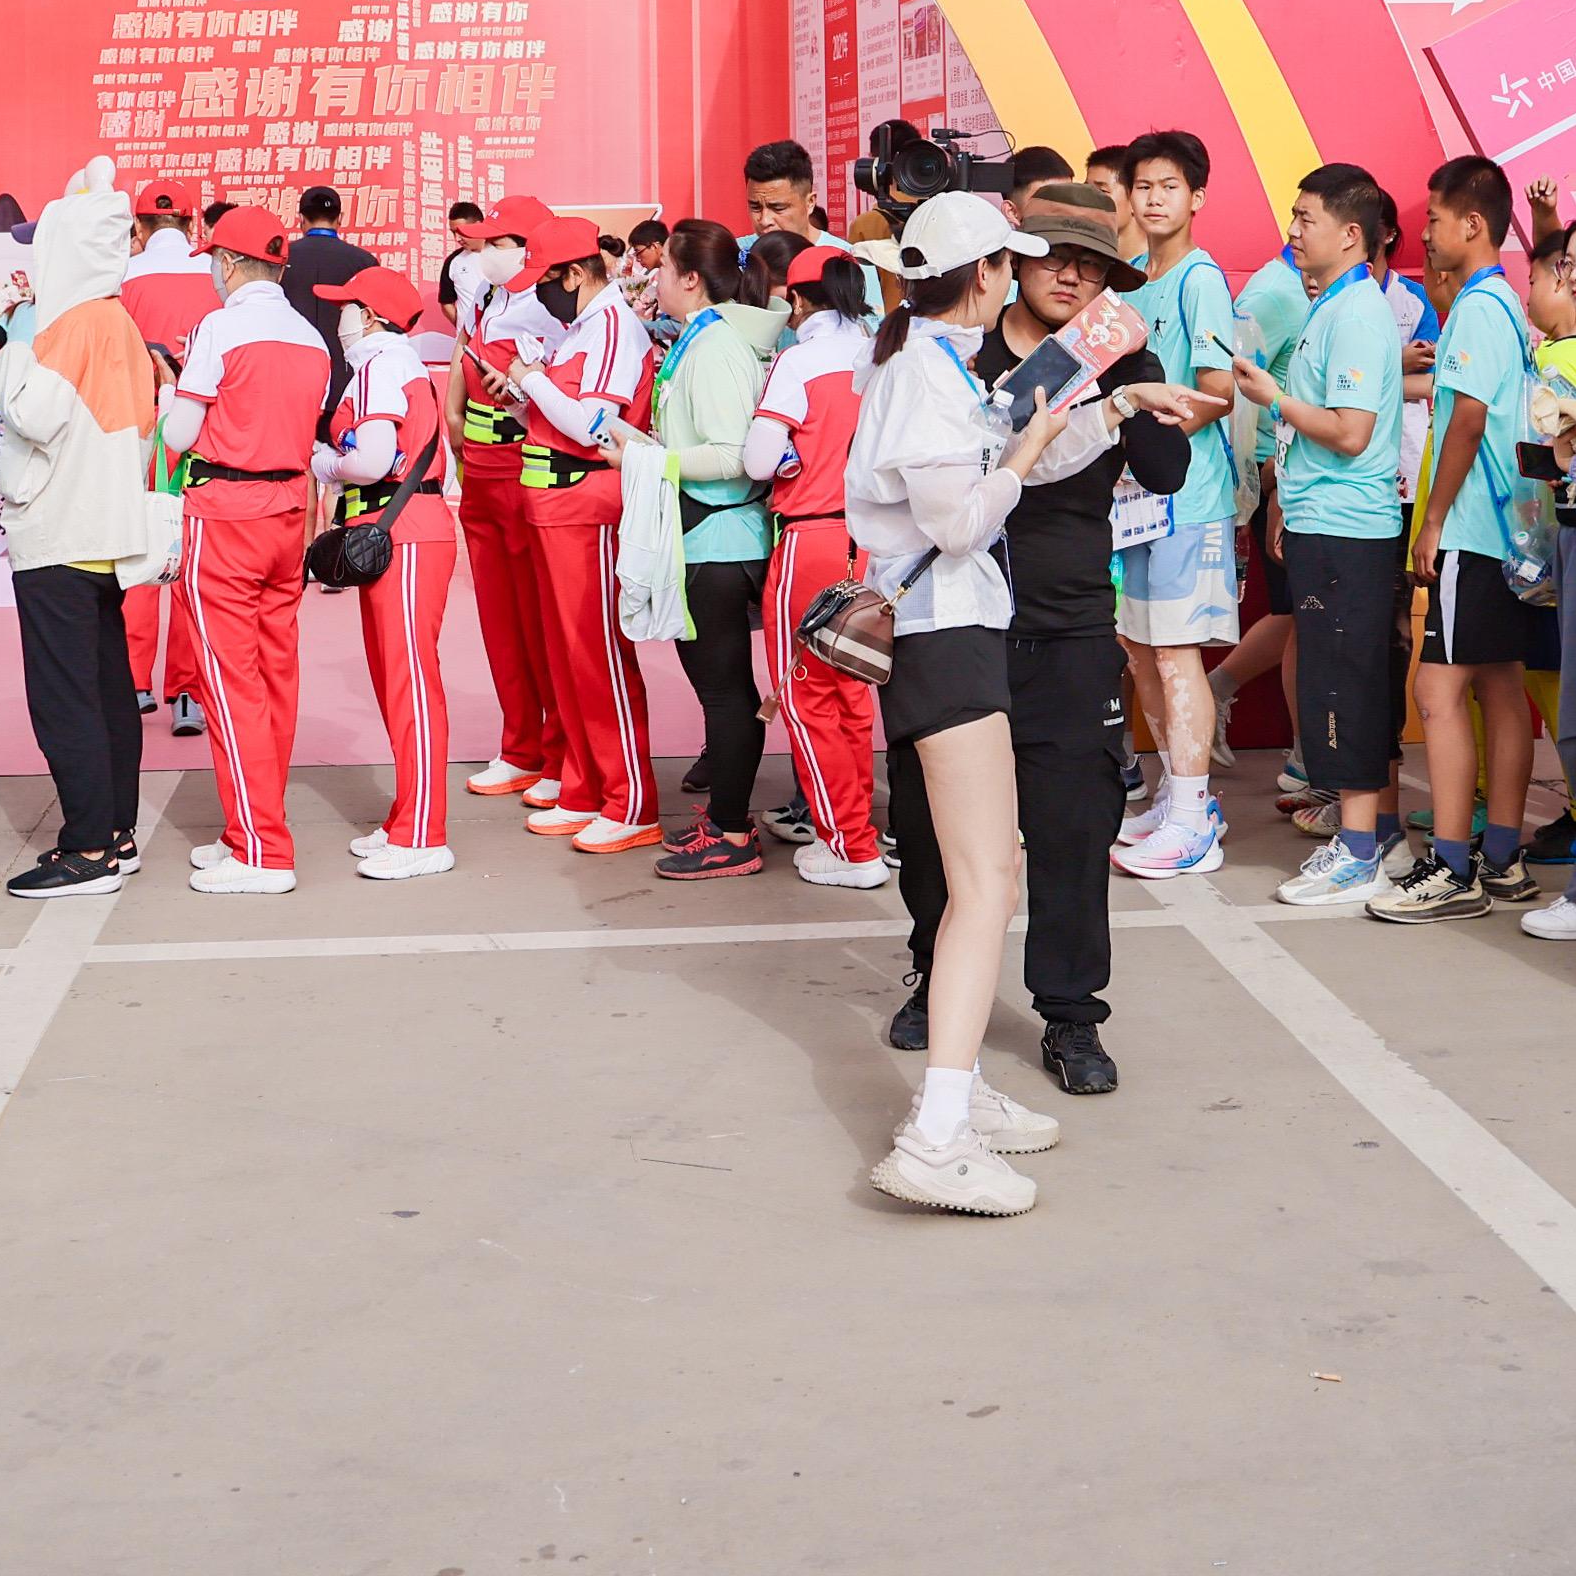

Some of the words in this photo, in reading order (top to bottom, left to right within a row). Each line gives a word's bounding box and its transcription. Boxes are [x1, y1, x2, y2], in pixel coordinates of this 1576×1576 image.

[429, 1, 529, 24] 感谢有你
[112, 9, 298, 39] 感谢有你相伴
[337, 19, 394, 43] 感谢
[99, 46, 214, 65] 感谢有你相伴
[232, 40, 261, 53] 感谢
[274, 46, 381, 64] 感谢有你相伴
[414, 39, 546, 60] 感谢有你相伴
[179, 62, 556, 118] 感谢有你相伴
[97, 91, 177, 109] 有你相伴
[99, 110, 166, 138] 感谢
[166, 124, 250, 138] 感谢有你相伴
[263, 121, 318, 145] 感谢
[323, 122, 414, 137] 感谢有你相伴
[474, 116, 541, 132] 感谢有你
[116, 152, 213, 169] 感谢有你相伴
[214, 145, 392, 172] 感谢有你相伴
[333, 171, 362, 185] 感谢
